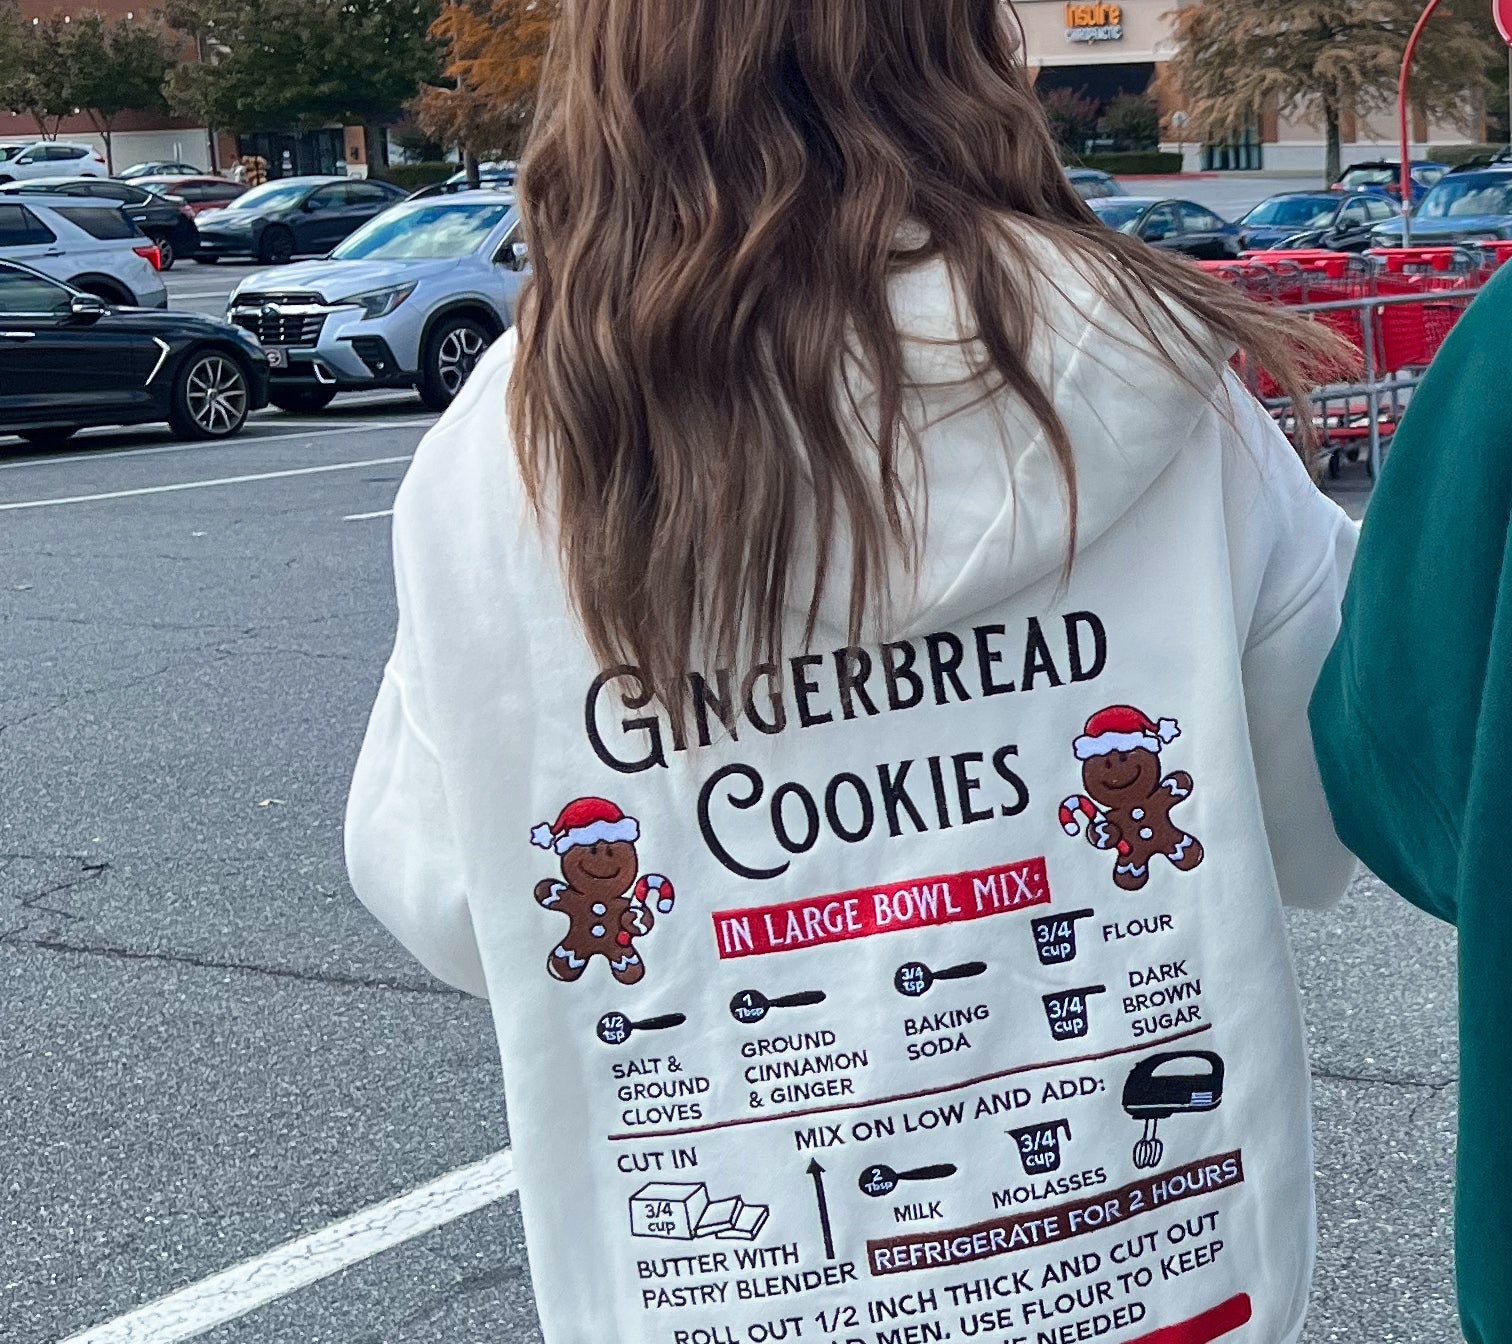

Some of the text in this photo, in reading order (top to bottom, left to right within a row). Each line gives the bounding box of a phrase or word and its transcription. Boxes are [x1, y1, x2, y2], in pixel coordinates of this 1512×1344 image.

[697, 745, 1029, 879] COOKIES
[720, 867, 1044, 954] IN LARGE BOWL MIX:
[1037, 920, 1072, 943] 3/4
[1102, 914, 1174, 943] FLOUR
[1041, 942, 1071, 958] cup
[902, 966, 924, 981] 3/4
[902, 980, 925, 993] tsp
[1128, 959, 1188, 988] DARK
[742, 993, 752, 1007] 1
[1048, 997, 1084, 1018] 3/4
[1122, 979, 1202, 1014] BROWN
[601, 1015, 624, 1030] 1/2
[904, 1004, 990, 1037] BAKING
[1053, 1017, 1084, 1035] cup
[1131, 1005, 1202, 1038] SUGAR
[602, 1029, 625, 1044] tsp
[741, 1030, 836, 1058] GROUND
[907, 1032, 972, 1061] SODA
[612, 1056, 683, 1080] SALT &
[744, 1049, 869, 1084] CINNAMON
[617, 1077, 710, 1102] GROUND
[750, 1078, 856, 1109] & GINGER
[622, 1103, 703, 1126] CLOVES
[794, 1076, 1106, 1151] MIX ON LOW AND ADD:
[1020, 1130, 1056, 1153] 3/4
[617, 1146, 698, 1173] CUT IN
[1025, 1151, 1056, 1170] cup
[871, 1168, 882, 1182] 2
[992, 1167, 1107, 1209] MOLASSES
[644, 1202, 673, 1220] 3/4
[873, 1158, 1239, 1271] REFRIGERATE FOR 2 HOURS
[893, 1201, 943, 1223] MILK
[647, 1221, 676, 1234] cup
[637, 1242, 800, 1279] BUTTER WITH
[642, 1260, 859, 1309] PASTRY BLENDER
[747, 1316, 804, 1343] OUT
[814, 1305, 860, 1333] 1/2
[868, 1288, 938, 1323] INCH
[943, 1268, 1032, 1305] THICK
[1041, 1251, 1102, 1289] AND
[1110, 1230, 1159, 1264] CUT
[1166, 1210, 1220, 1244] OUT
[959, 1308, 1014, 1336] USE
[1022, 1280, 1114, 1326] FLOUR
[1116, 1267, 1153, 1294] TO
[1160, 1239, 1224, 1281] KEEP
